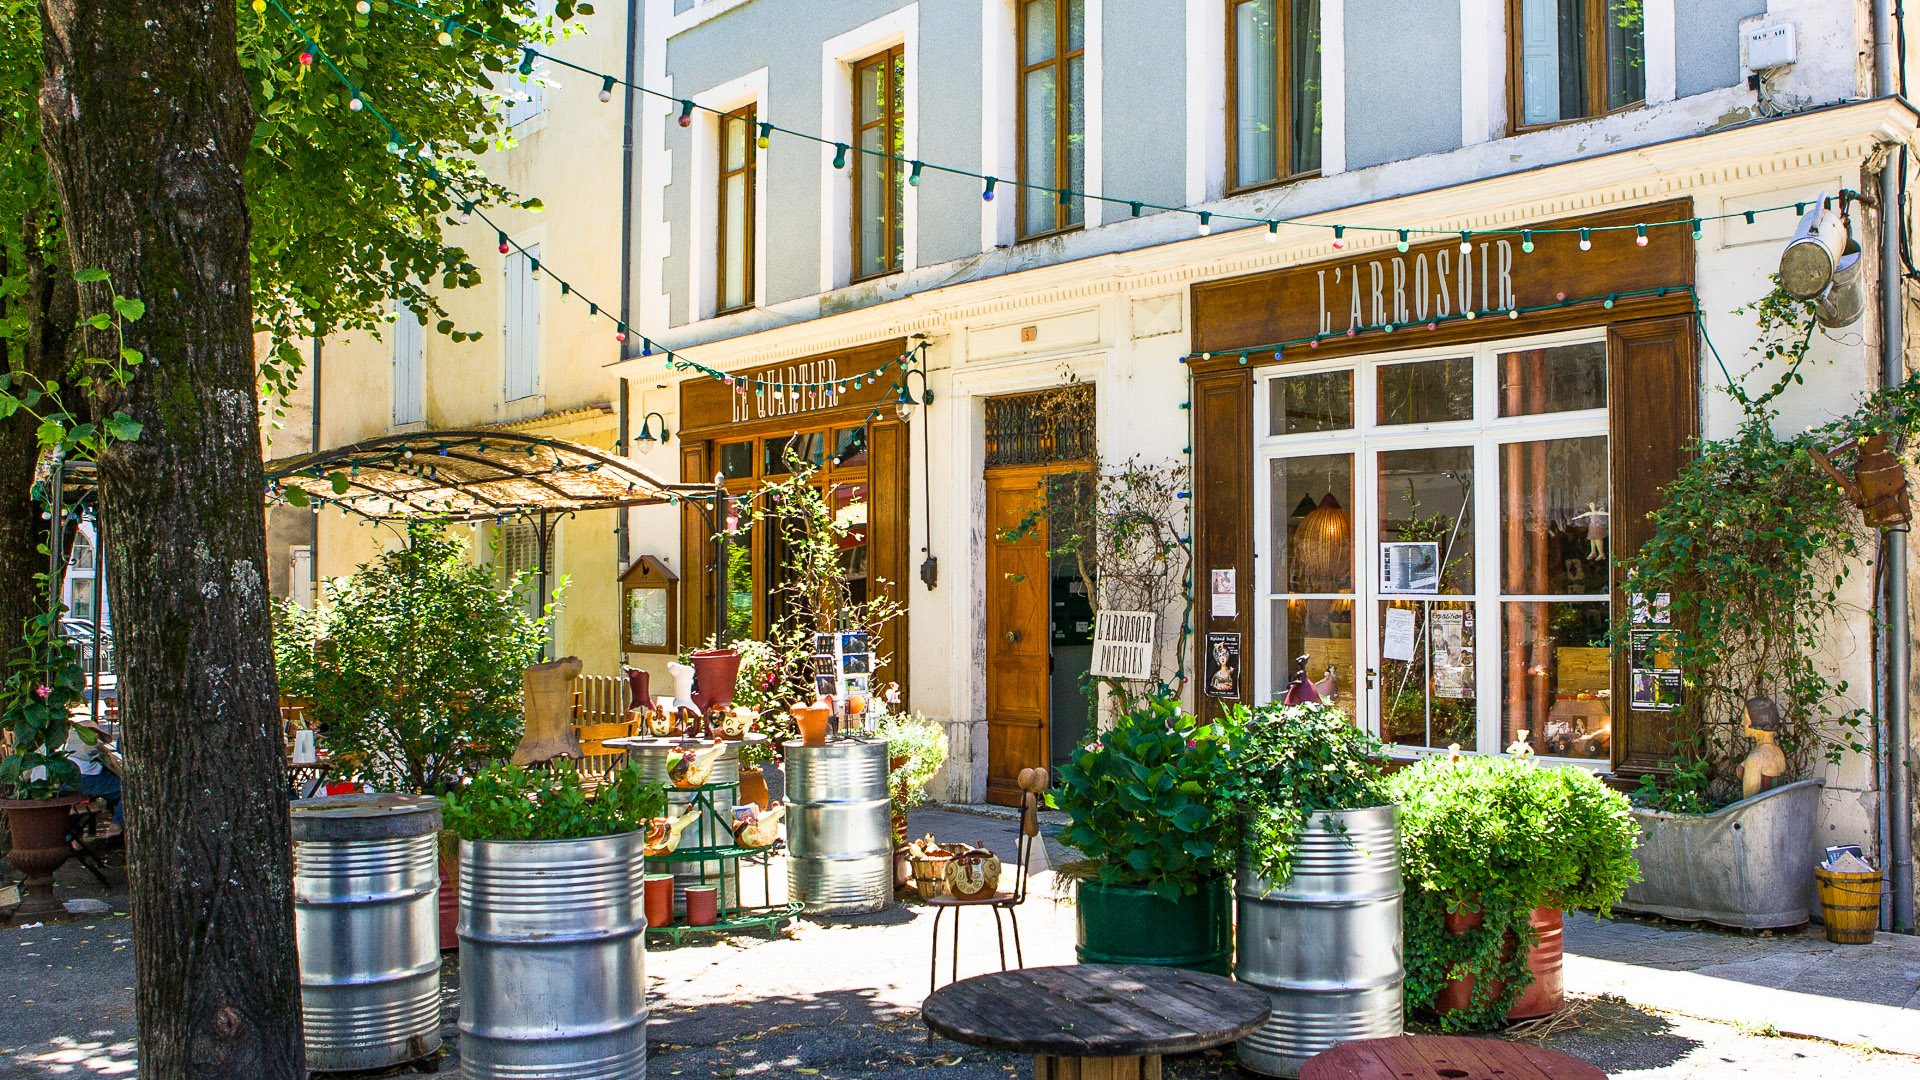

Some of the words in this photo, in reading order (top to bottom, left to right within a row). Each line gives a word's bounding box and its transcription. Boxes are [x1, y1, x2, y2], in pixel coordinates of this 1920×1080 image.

[1318, 240, 1516, 335] L'ARROSOIR
[732, 375, 749, 423] LE
[757, 359, 839, 419] QUARTIER
[1098, 613, 1151, 643] L'ARROSOIR
[1432, 612, 1462, 621] Eposition
[1100, 645, 1144, 674] POTERIES
